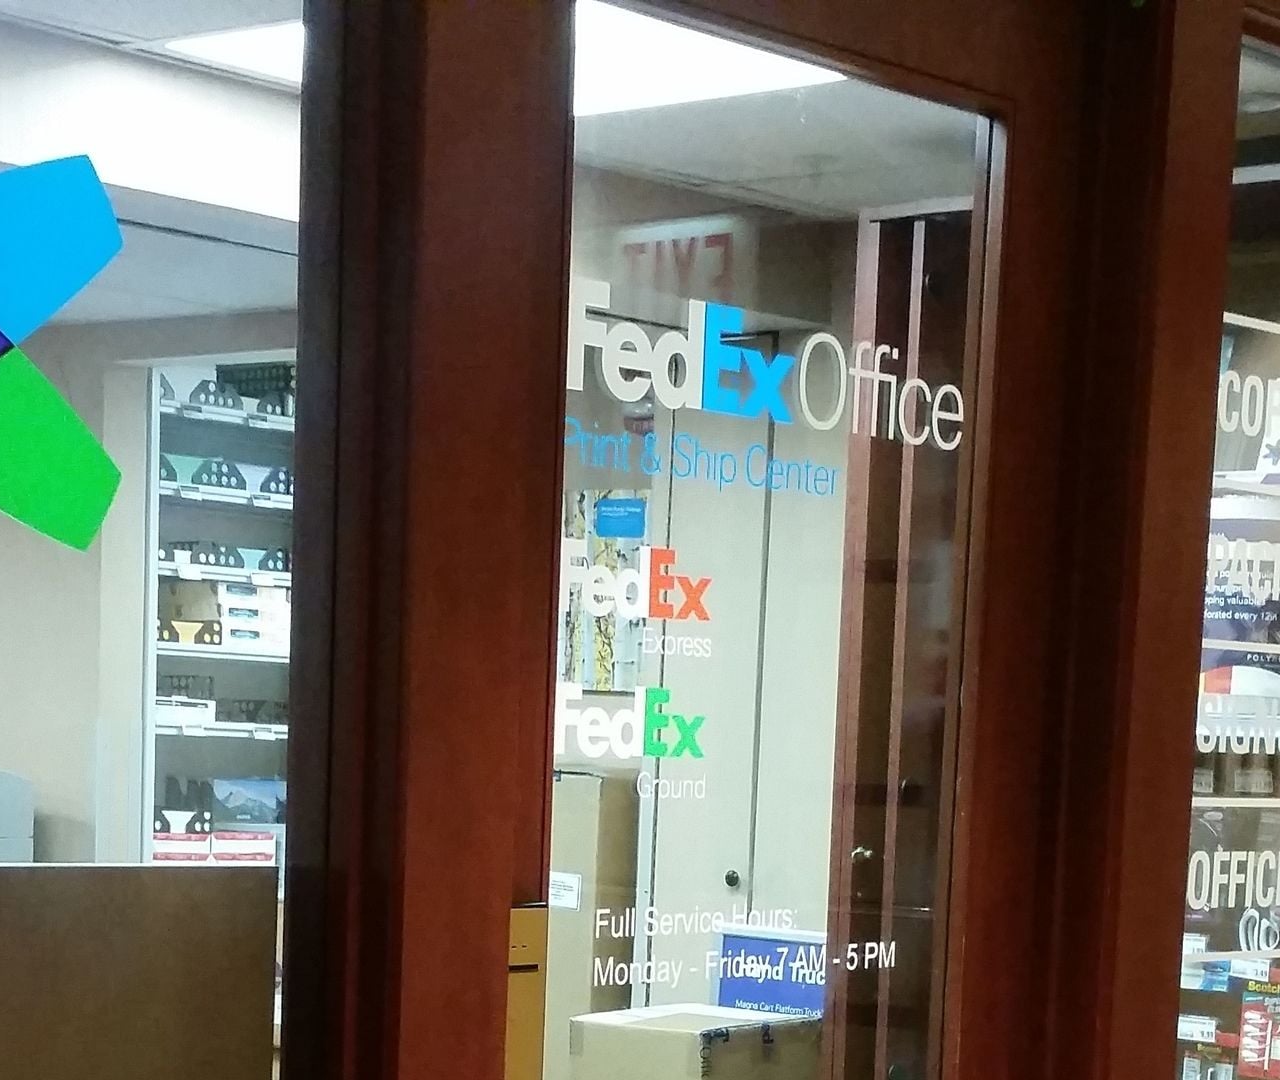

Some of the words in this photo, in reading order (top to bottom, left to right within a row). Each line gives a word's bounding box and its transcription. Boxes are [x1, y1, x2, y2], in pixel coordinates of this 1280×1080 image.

[566, 278, 797, 425] FedEx
[798, 332, 965, 451] Office
[564, 415, 632, 474] Print
[640, 431, 662, 474] &
[673, 432, 738, 489] Ship
[745, 443, 840, 496] Center
[557, 537, 713, 622] FedEx
[641, 627, 713, 659] Express
[554, 681, 706, 760] FedEx
[636, 771, 707, 800] Ground
[594, 907, 636, 939] Full
[642, 904, 724, 938] Service
[732, 901, 798, 932] Hours:
[593, 954, 683, 998] Monday
[705, 948, 770, 984] Friday
[776, 946, 789, 977] 7
[794, 944, 827, 972] AM
[846, 943, 859, 971] 5
[864, 940, 897, 970] PM
